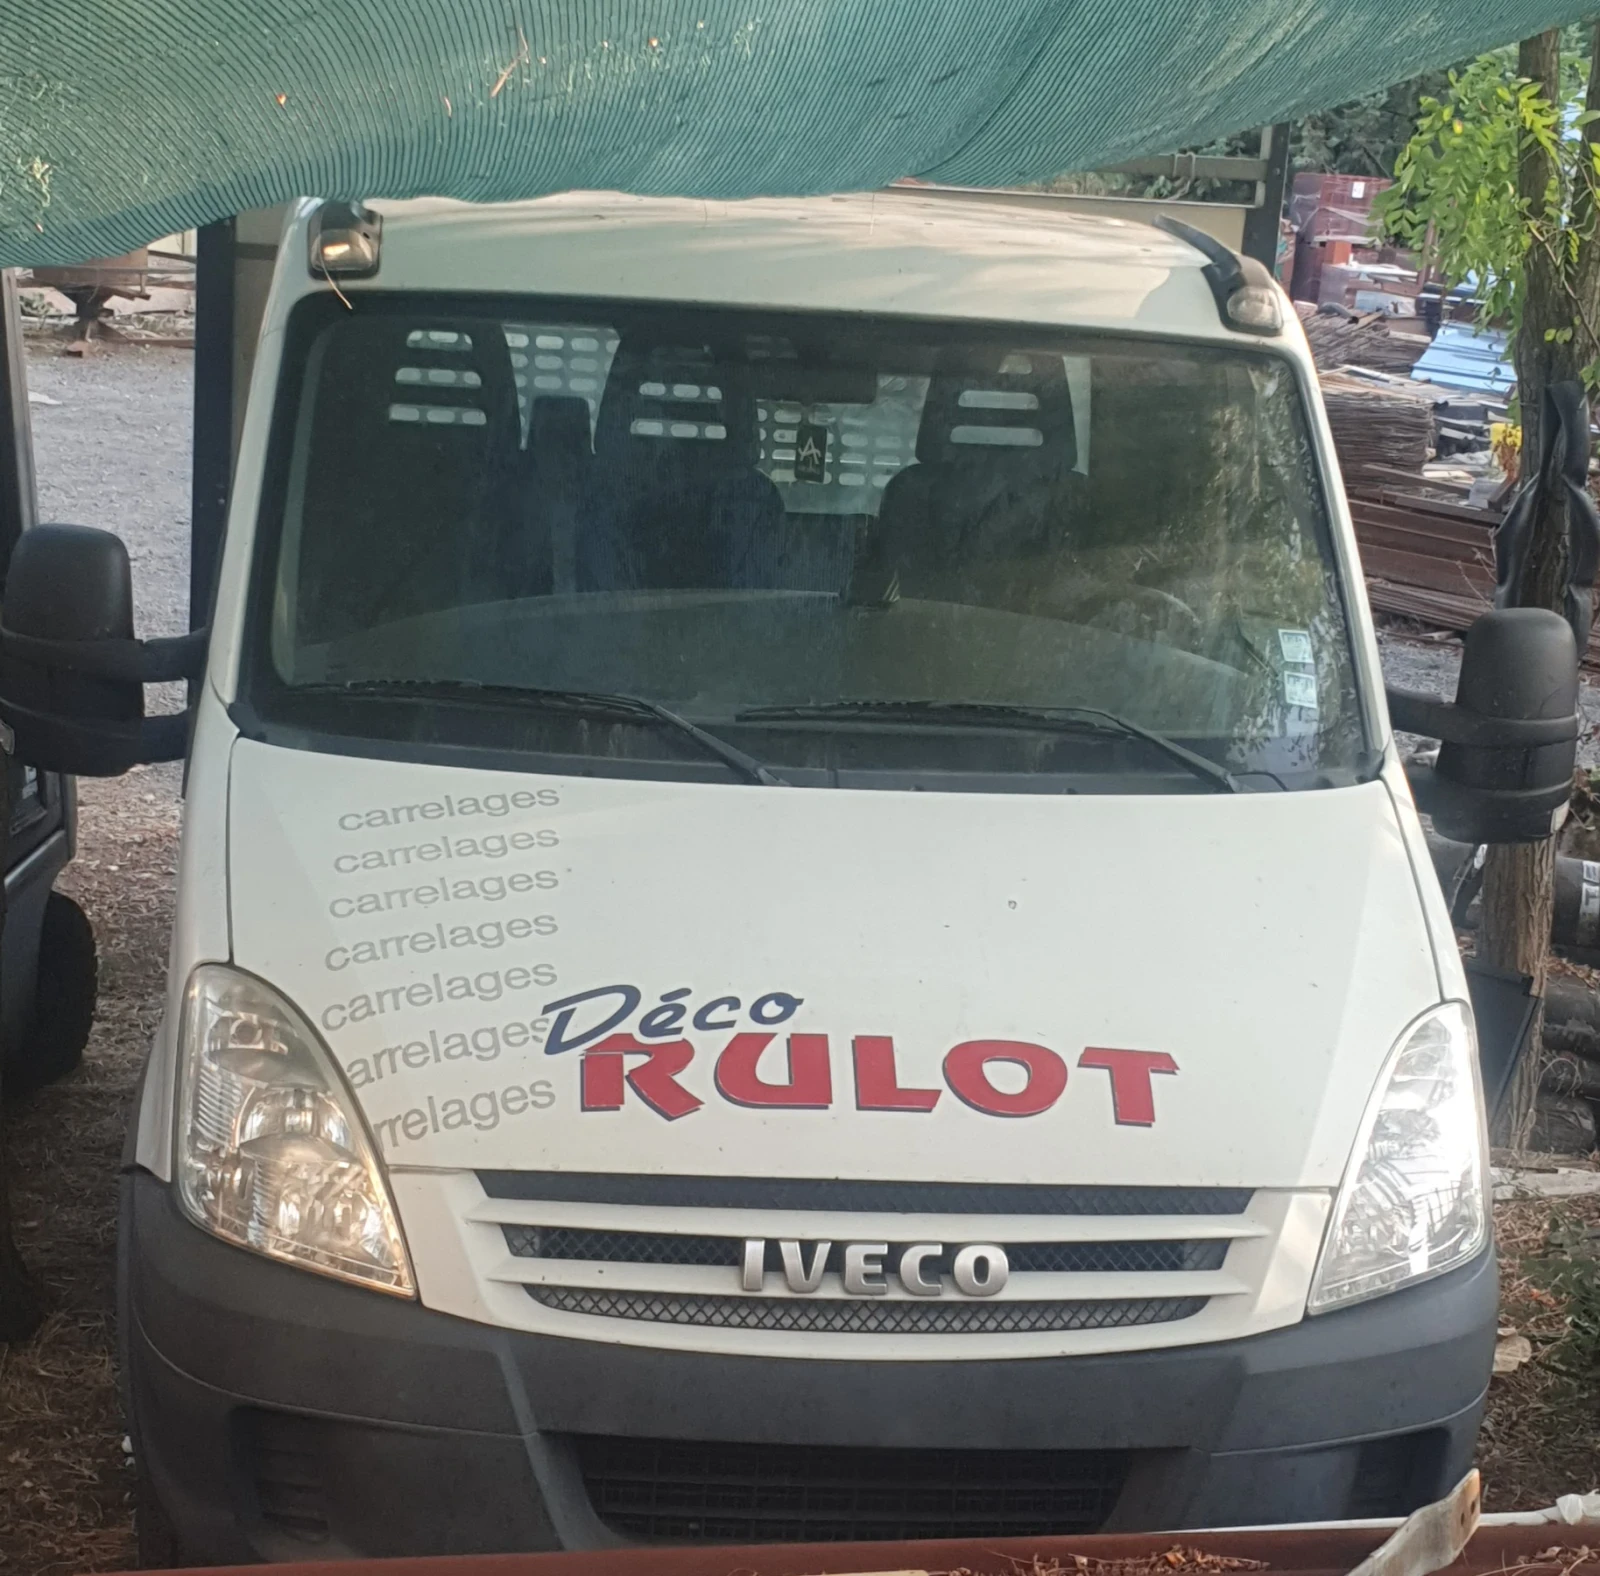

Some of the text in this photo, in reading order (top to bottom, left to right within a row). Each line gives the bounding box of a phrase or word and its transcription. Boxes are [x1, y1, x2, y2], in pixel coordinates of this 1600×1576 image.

[338, 789, 560, 831] carrelages
[333, 829, 560, 874] carrelages
[329, 870, 559, 919] carrelages
[325, 914, 559, 971] carrelages
[321, 963, 558, 1031] carrelages
[541, 984, 805, 1057] Déco
[580, 1032, 1180, 1128] RULOT
[740, 1238, 1010, 1298] IVECO
